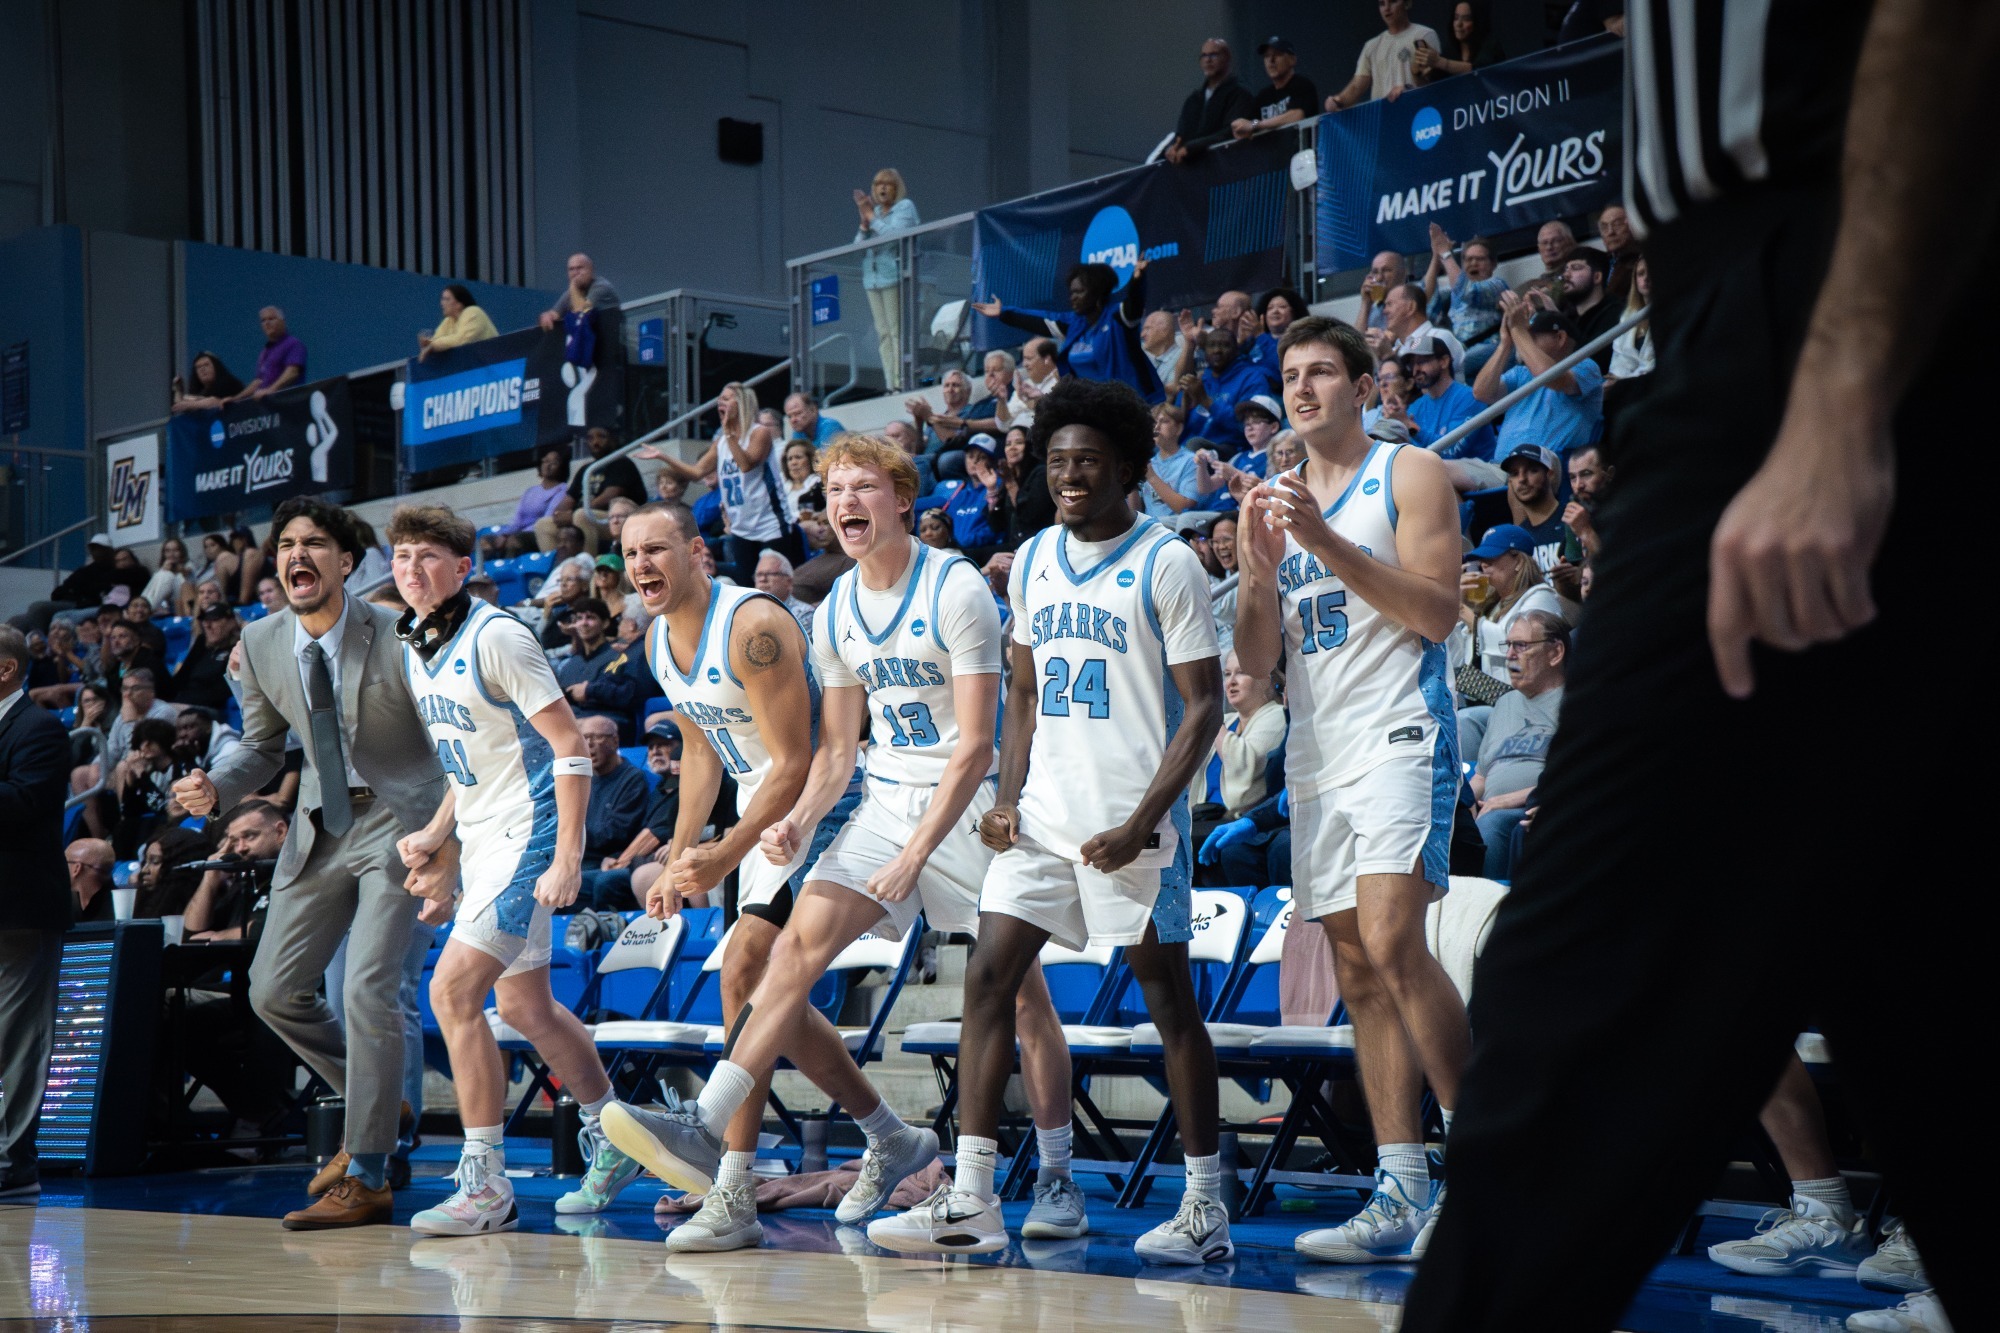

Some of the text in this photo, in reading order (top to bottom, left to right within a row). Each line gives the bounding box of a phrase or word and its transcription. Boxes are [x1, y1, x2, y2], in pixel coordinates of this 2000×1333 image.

[1453, 84, 1550, 131] DIVISION
[1558, 78, 1570, 102] II
[1376, 130, 1606, 224] MAKE IT YOURS
[1088, 242, 1179, 268] NCAA com
[423, 376, 522, 430] CHAMPIONS
[195, 444, 294, 494] MAKE IT YOURS
[1031, 602, 1128, 654] SHARKS
[1298, 590, 1349, 656] 15
[856, 657, 946, 694] HARKS
[1042, 656, 1110, 720] 24
[883, 702, 941, 747] 13
[437, 739, 478, 787] 41
[704, 728, 753, 775] 11
[621, 929, 658, 946] Sharks
